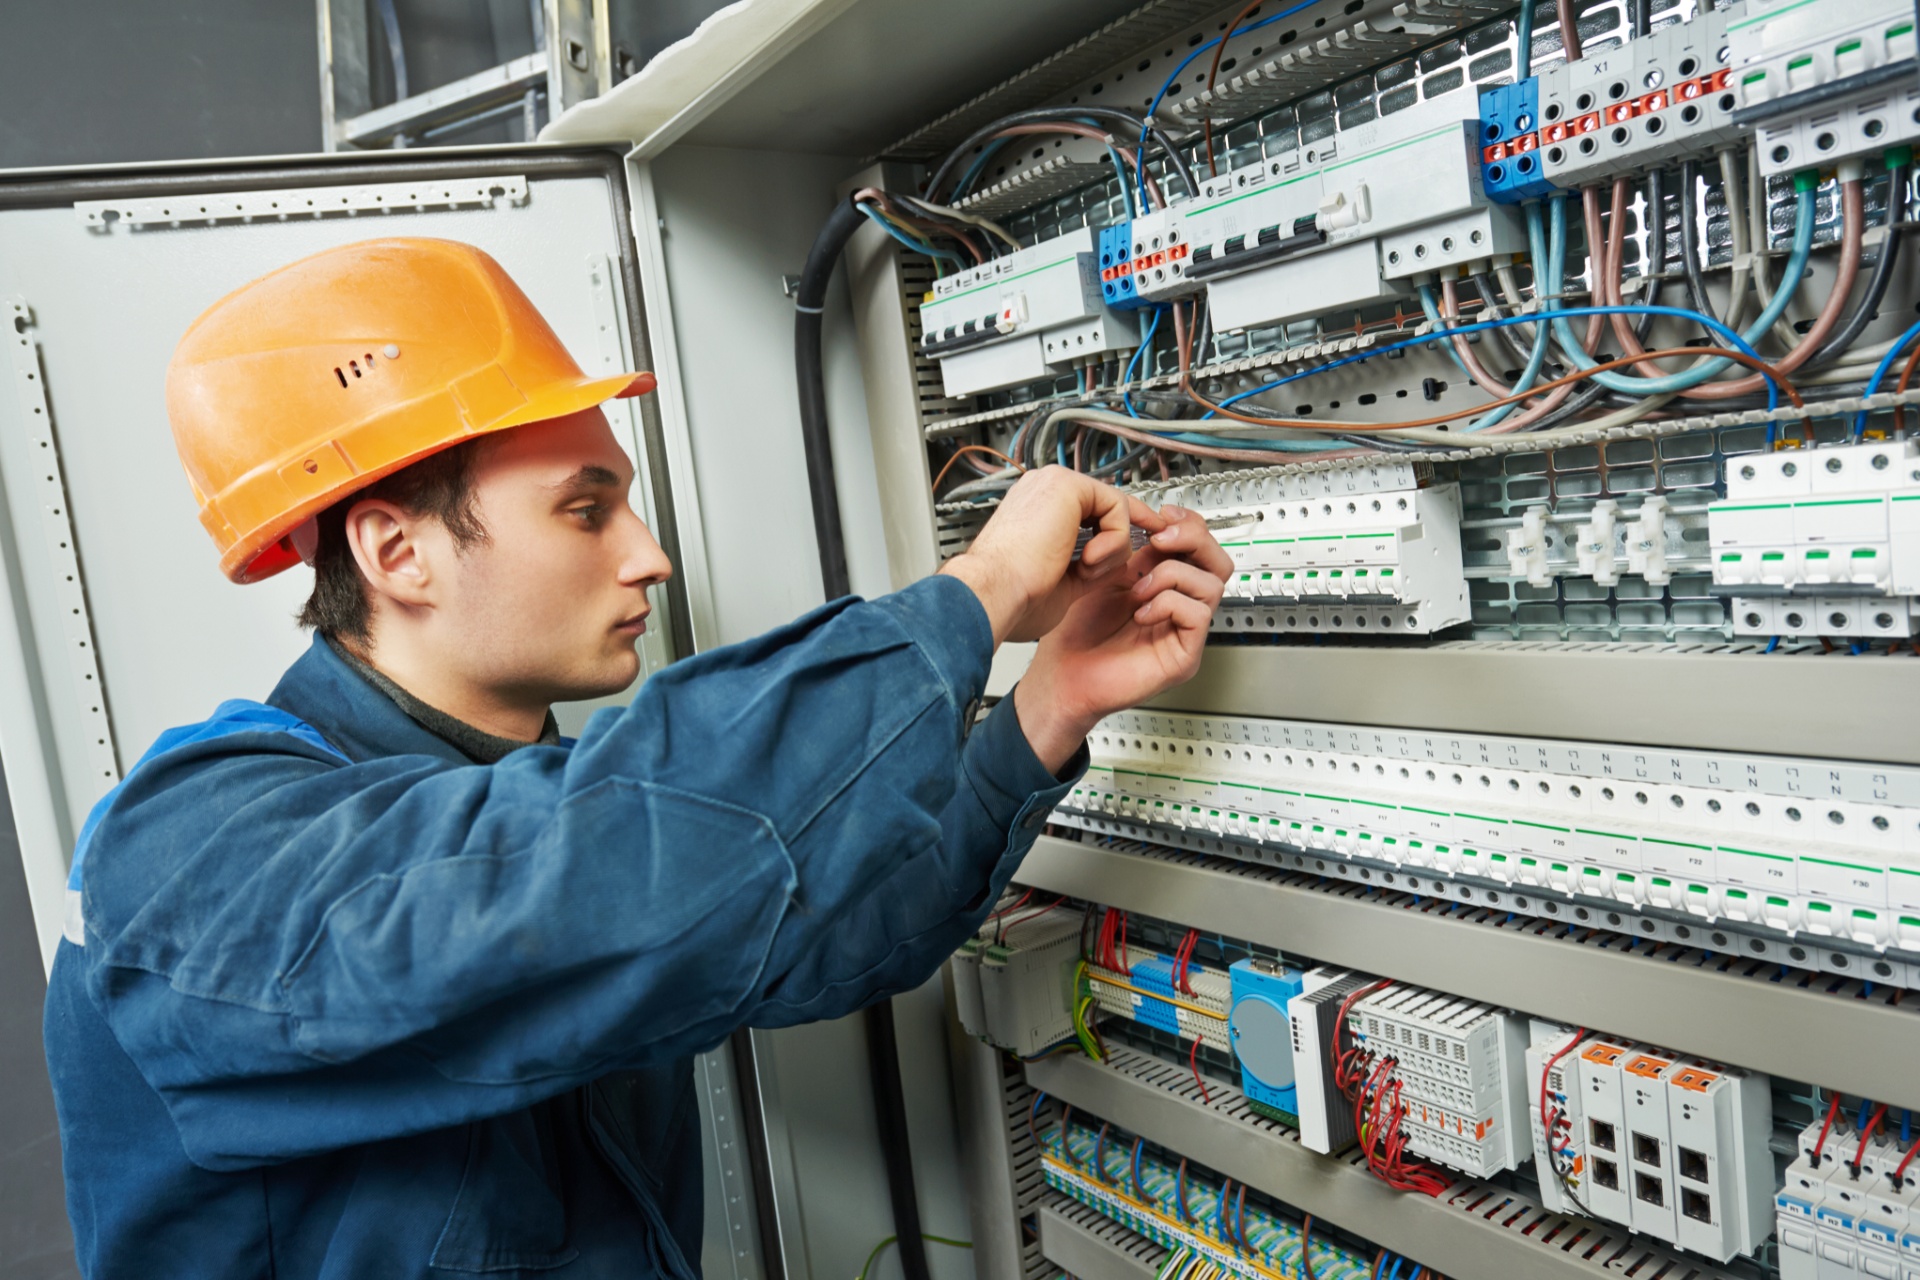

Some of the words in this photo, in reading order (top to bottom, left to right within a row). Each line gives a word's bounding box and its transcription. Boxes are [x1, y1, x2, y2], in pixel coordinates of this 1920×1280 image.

[1594, 61, 1607, 75] X1
[1371, 468, 1377, 476] N
[1480, 743, 1486, 751] N
[1538, 748, 1546, 756] N
[1602, 753, 1610, 761] N
[1635, 756, 1645, 764] L2
[1671, 759, 1679, 767] N
[1707, 762, 1718, 770] L1
[1747, 765, 1756, 774] N
[1786, 768, 1799, 777] L3
[1830, 771, 1839, 780] N
[1873, 775, 1887, 785] L2
[1540, 760, 1547, 768] N
[1604, 766, 1611, 774] N
[1636, 768, 1647, 777] L2
[1673, 772, 1681, 780] N
[1708, 775, 1720, 784] L3
[1749, 778, 1757, 787] N
[1788, 782, 1800, 791] L1
[1832, 785, 1841, 795] N
[1874, 789, 1888, 799] L2
[1768, 869, 1783, 877] F29
[1853, 880, 1869, 888] F30
[1828, 1218, 1838, 1226] R2
[1872, 1233, 1883, 1241] R3
